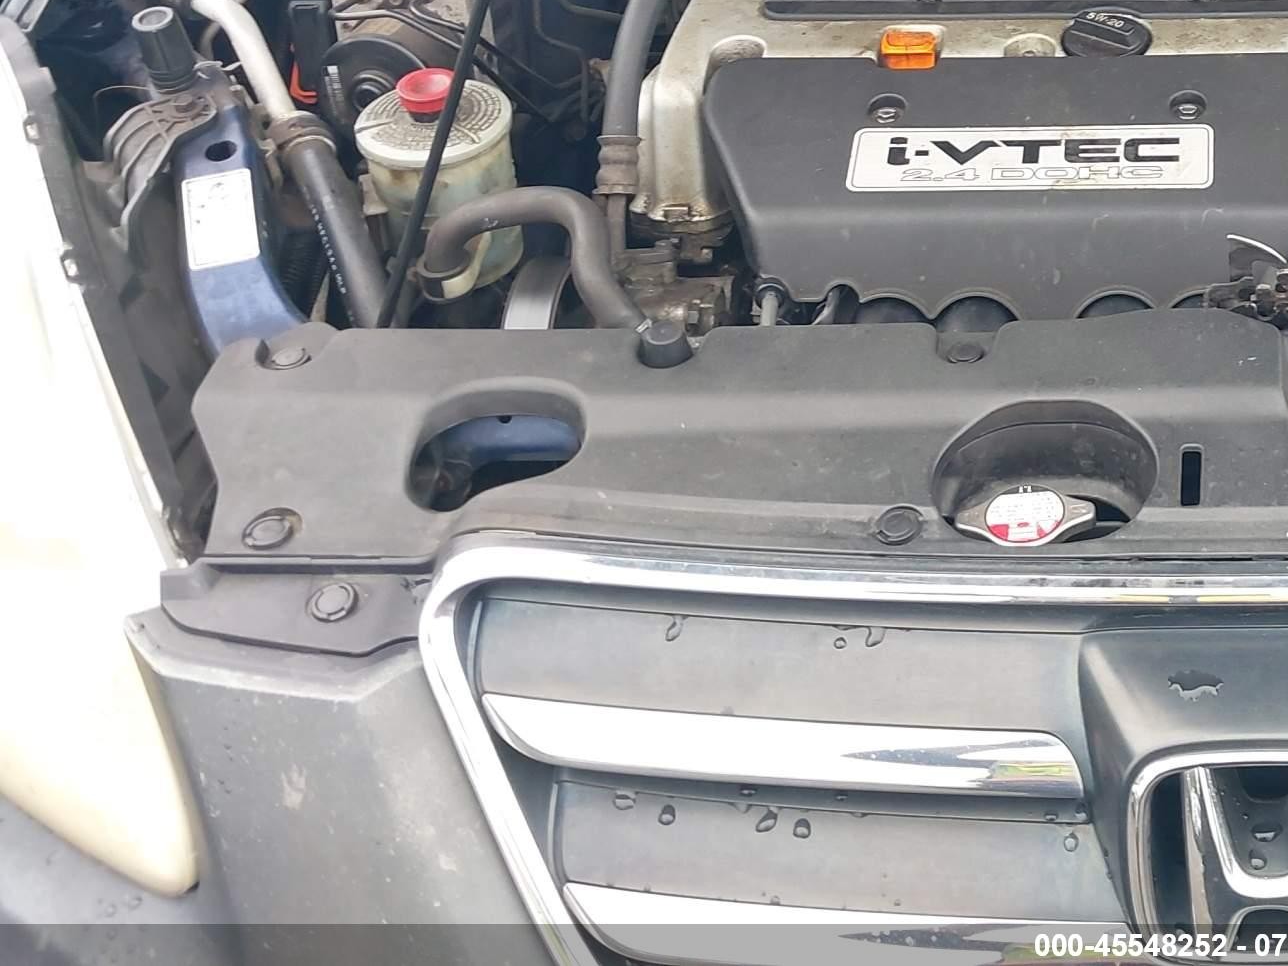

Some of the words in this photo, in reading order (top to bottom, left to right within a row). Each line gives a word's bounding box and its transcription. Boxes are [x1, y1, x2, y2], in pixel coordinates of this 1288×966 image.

[1086, 12, 1125, 28] 5W-20
[887, 136, 1180, 165] i-VTEC
[900, 167, 980, 182] 2.4
[990, 165, 1164, 181] DOHC
